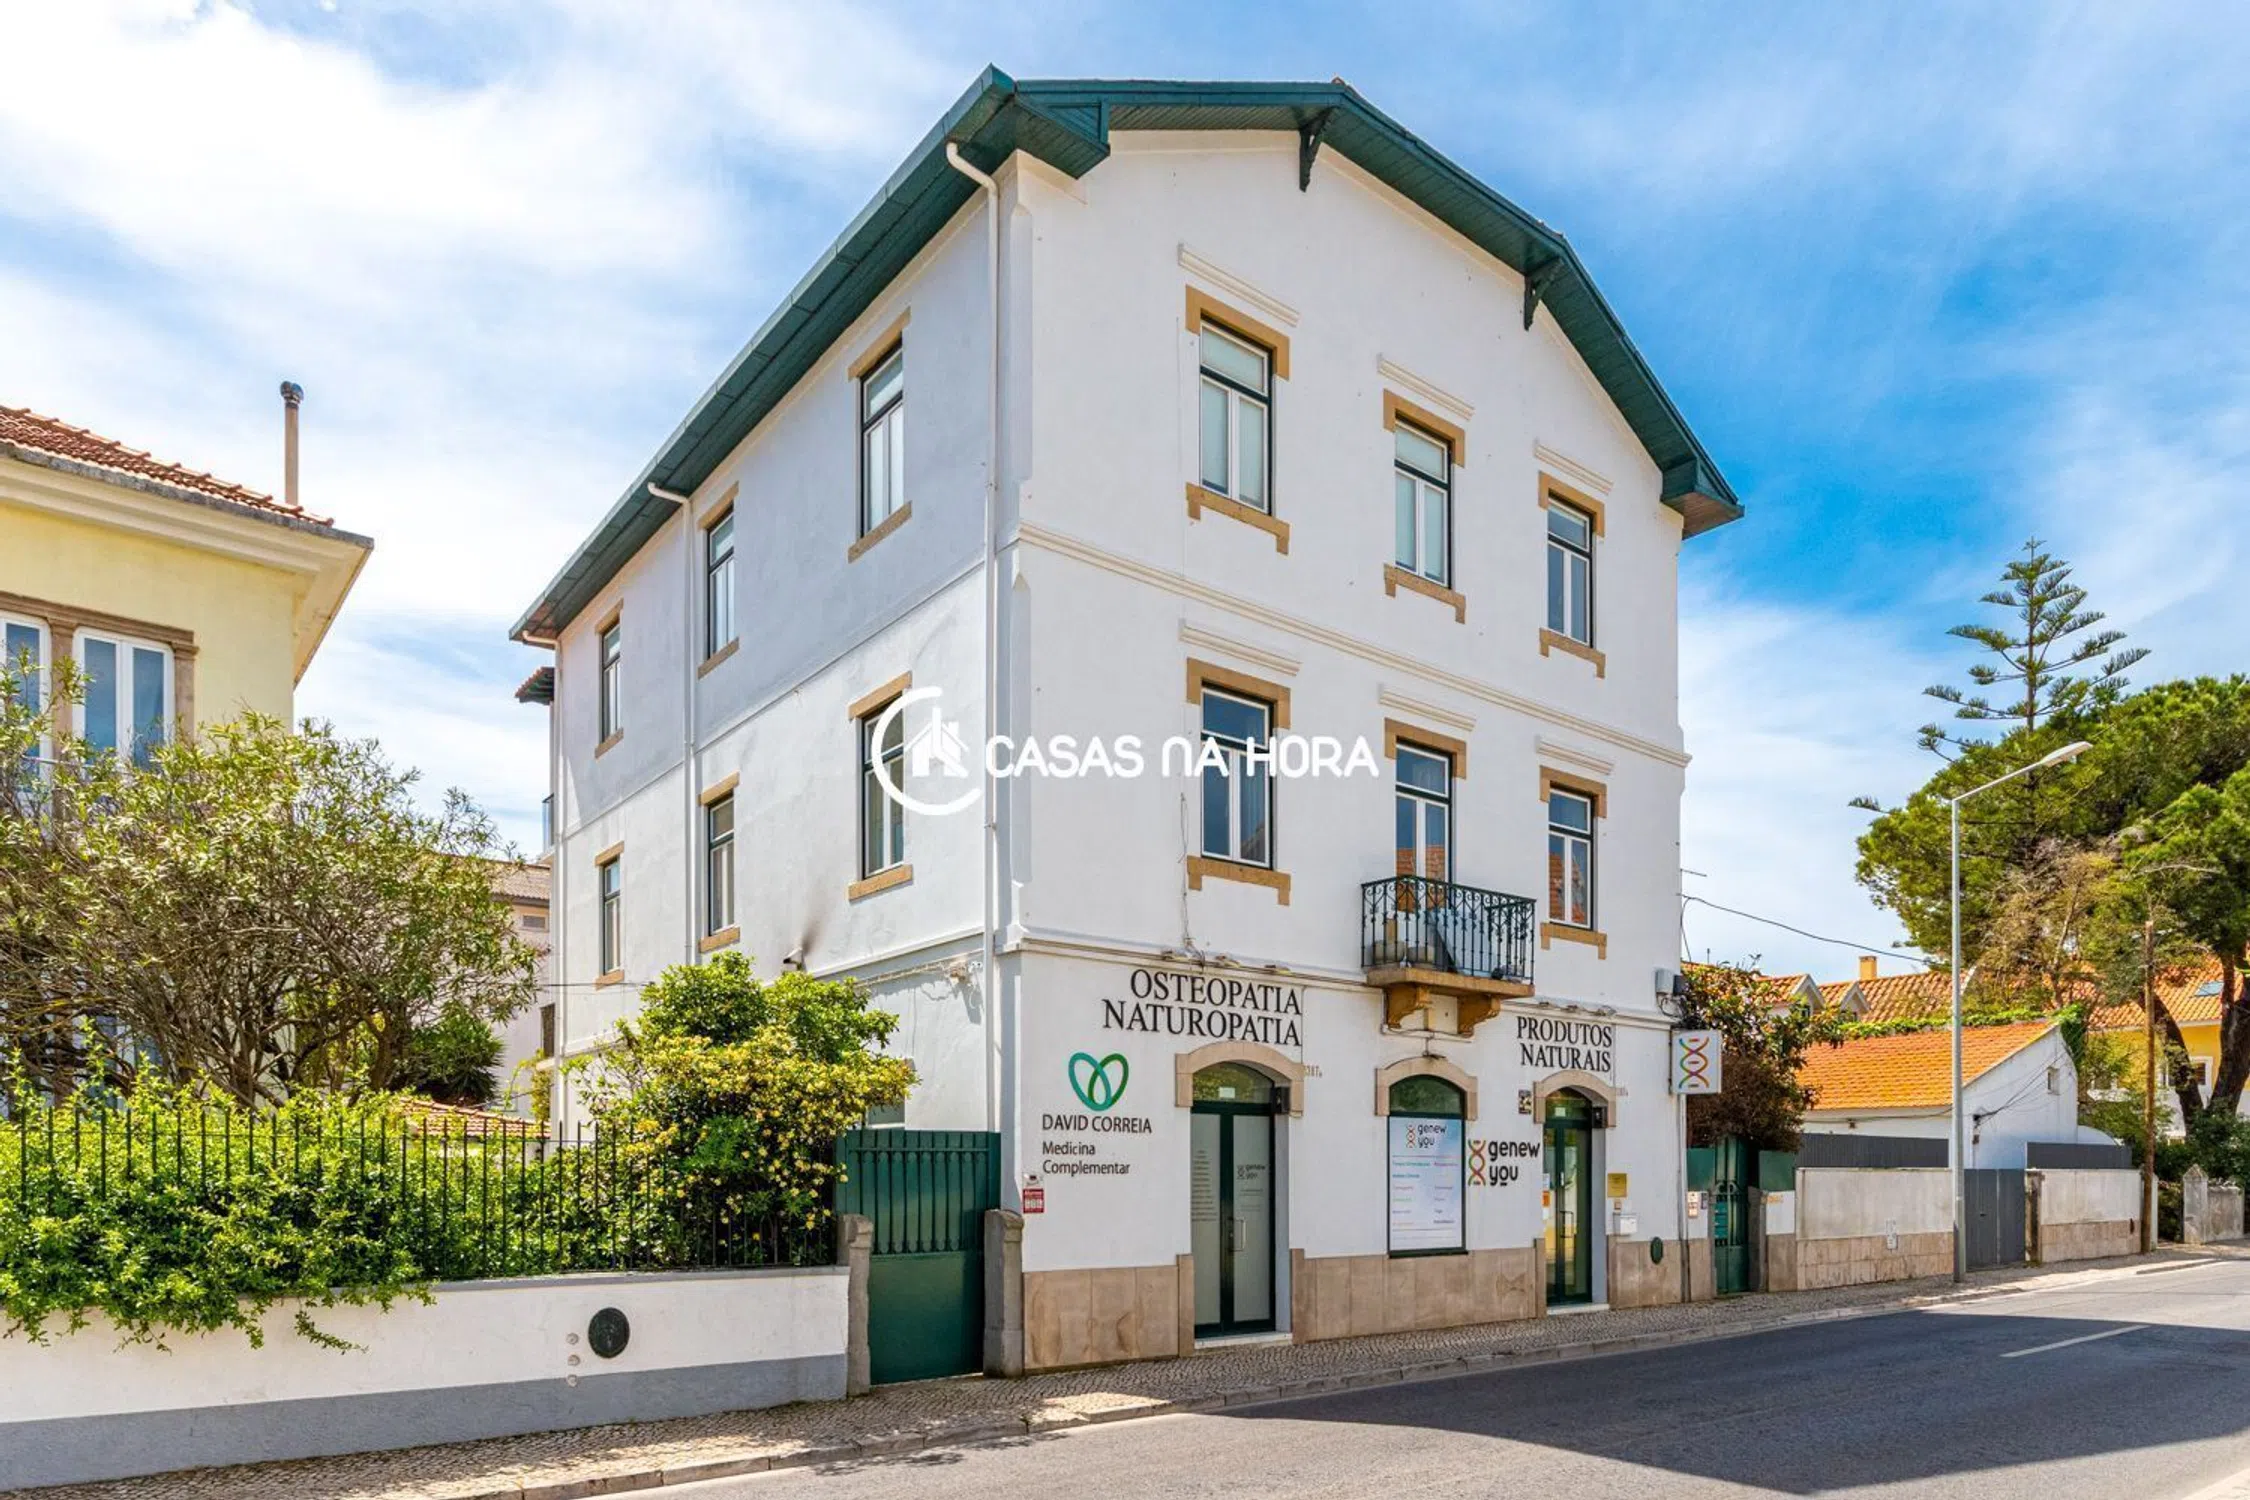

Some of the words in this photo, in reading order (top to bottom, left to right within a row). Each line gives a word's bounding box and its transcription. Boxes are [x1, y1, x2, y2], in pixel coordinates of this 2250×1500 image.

[1130, 968, 1303, 1015] OSTEOPATIA
[1102, 999, 1302, 1047] NATUROPATIA
[1516, 1016, 1612, 1048] PRODUTOS
[1520, 1043, 1611, 1072] NATURAIS
[1042, 1114, 1088, 1132] DAVID
[1091, 1115, 1152, 1134] CORREIA
[1417, 1124, 1447, 1135] genew
[1042, 1141, 1096, 1155] Medicina
[1417, 1137, 1435, 1149] you
[1488, 1141, 1540, 1162] genew
[1042, 1160, 1130, 1177] Complementar
[1489, 1166, 1518, 1186] you
